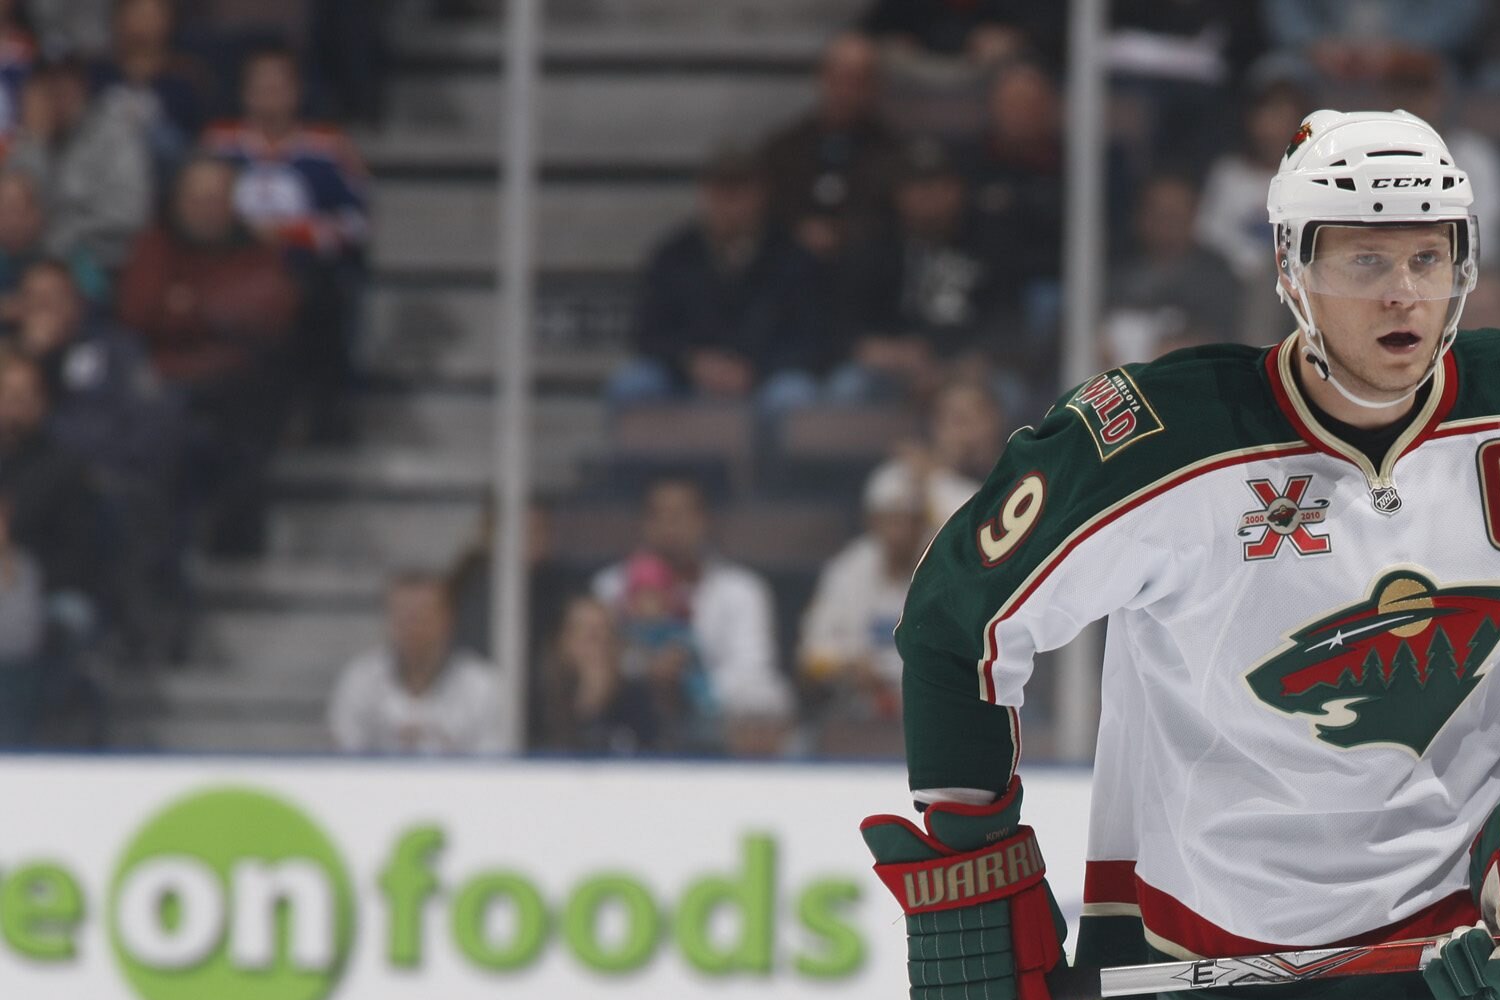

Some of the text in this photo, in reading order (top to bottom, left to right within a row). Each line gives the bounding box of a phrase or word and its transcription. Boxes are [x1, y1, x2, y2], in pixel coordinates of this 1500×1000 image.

[1371, 178, 1432, 189] CCM
[1075, 374, 1137, 445] WILD
[976, 470, 1047, 568] 9
[1245, 511, 1320, 524] 2000 2010
[1378, 489, 1396, 509] NHL
[116, 853, 336, 972] on
[378, 824, 870, 982] foods
[903, 834, 1045, 909] WARRI
